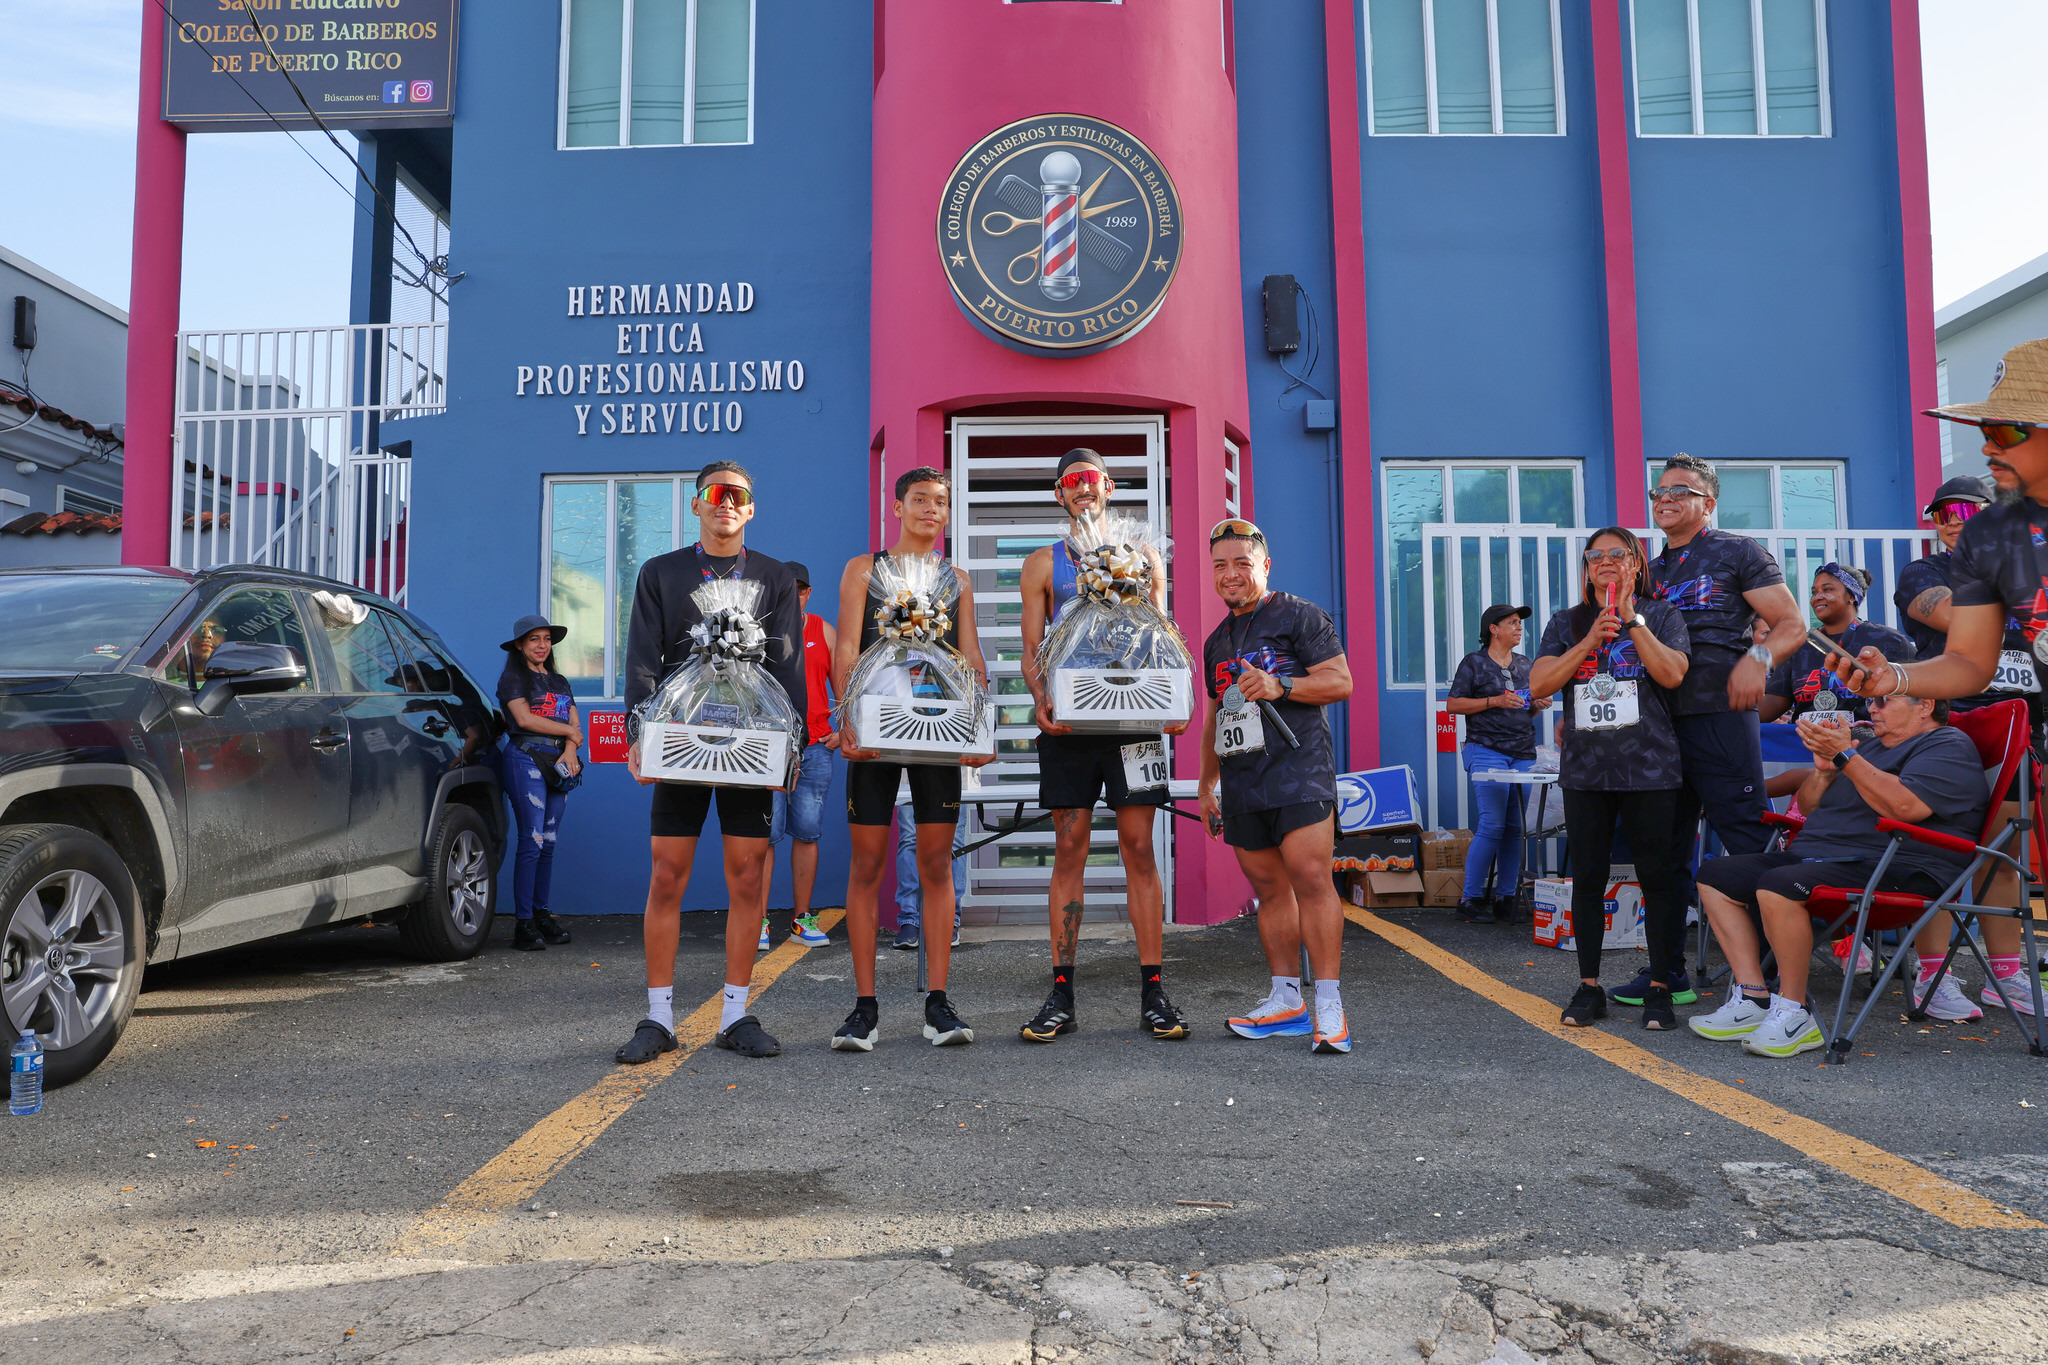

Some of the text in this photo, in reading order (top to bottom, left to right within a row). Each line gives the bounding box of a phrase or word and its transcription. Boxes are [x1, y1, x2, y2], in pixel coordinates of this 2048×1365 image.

[178, 21, 437, 43] COLEGIO DE BARBEROS
[211, 50, 402, 73] DE PUERTO RICO
[323, 93, 380, 102] Búscanos en:
[948, 125, 1174, 240] COLEGIO DE BARBEROS Y ESTILISTAS EN BARBERÍA
[1104, 216, 1137, 228] 1989
[567, 282, 755, 316] HERMANDAD
[978, 295, 1139, 337] PUERTO RICO
[617, 322, 704, 354] ETICA
[516, 360, 805, 396] PROFESIONALISMO
[574, 401, 743, 435] Y SERVICIO
[1992, 667, 2033, 687] 208
[541, 691, 572, 711] 5K
[1590, 704, 1617, 723] 96
[599, 736, 622, 744] PARA
[1223, 726, 1245, 748] 30
[1140, 762, 1167, 782] 109
